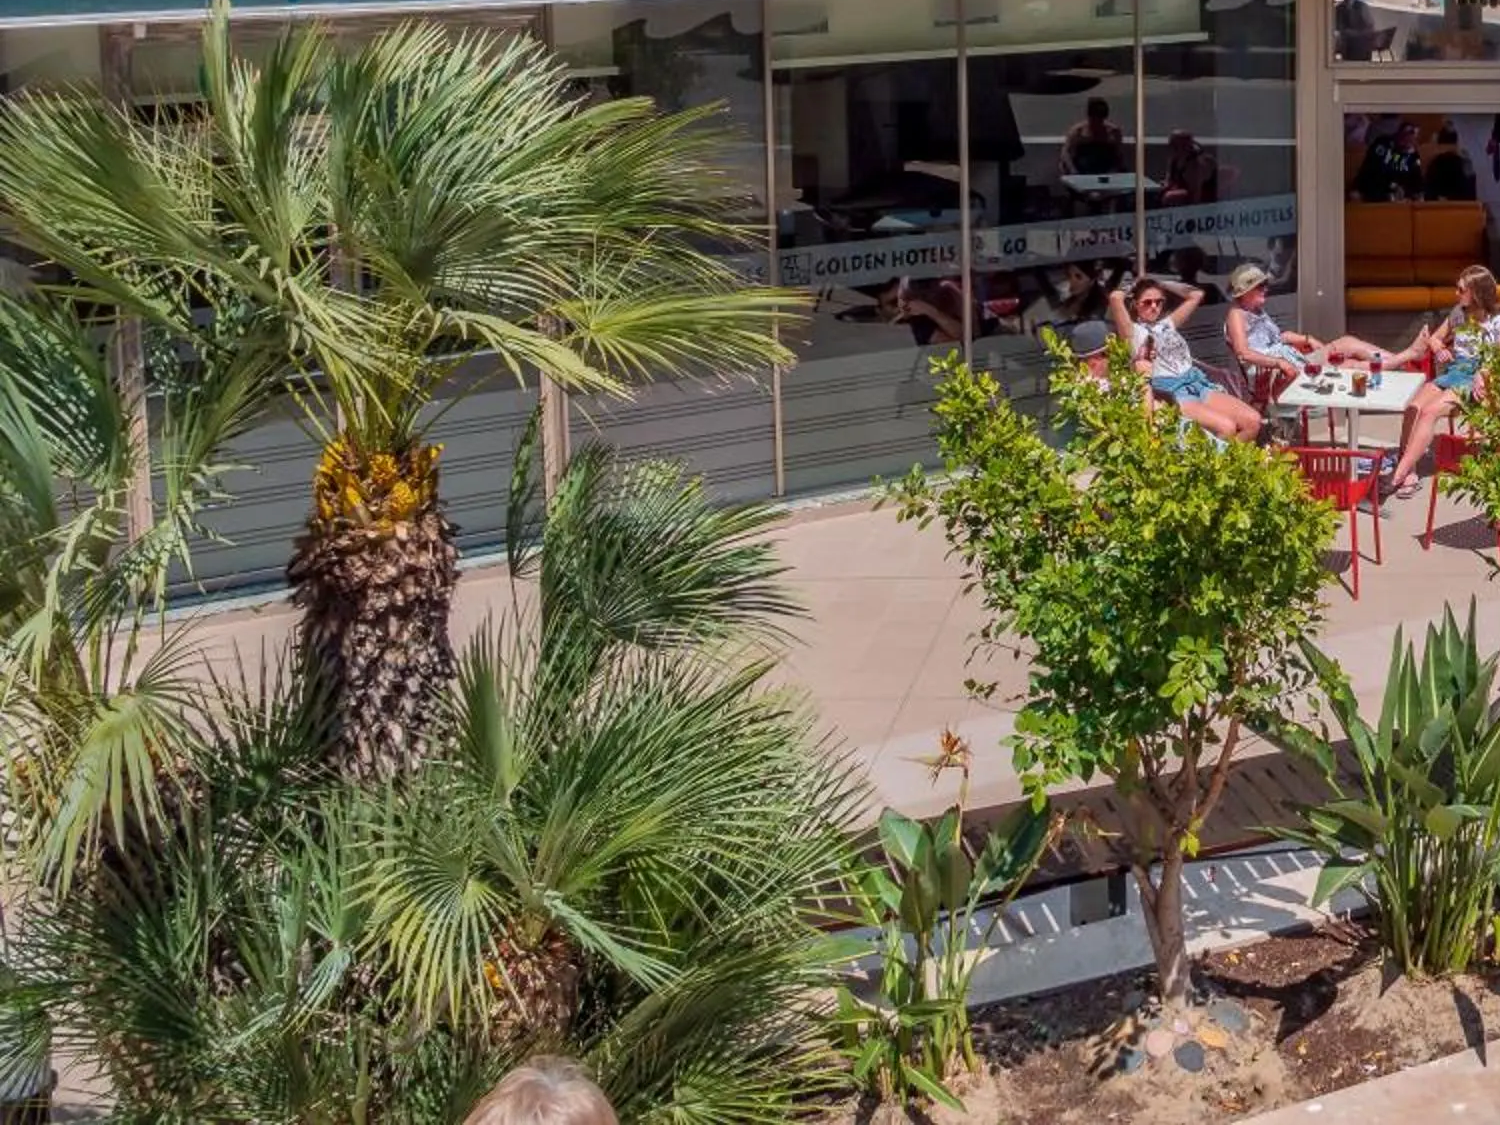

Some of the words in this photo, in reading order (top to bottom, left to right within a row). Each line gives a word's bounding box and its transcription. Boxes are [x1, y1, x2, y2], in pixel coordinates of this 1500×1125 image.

[1175, 213, 1235, 235] GOLDEN
[1239, 205, 1293, 225] HOTELS
[815, 250, 887, 276] GOLDEN
[891, 244, 956, 267] HOTELS
